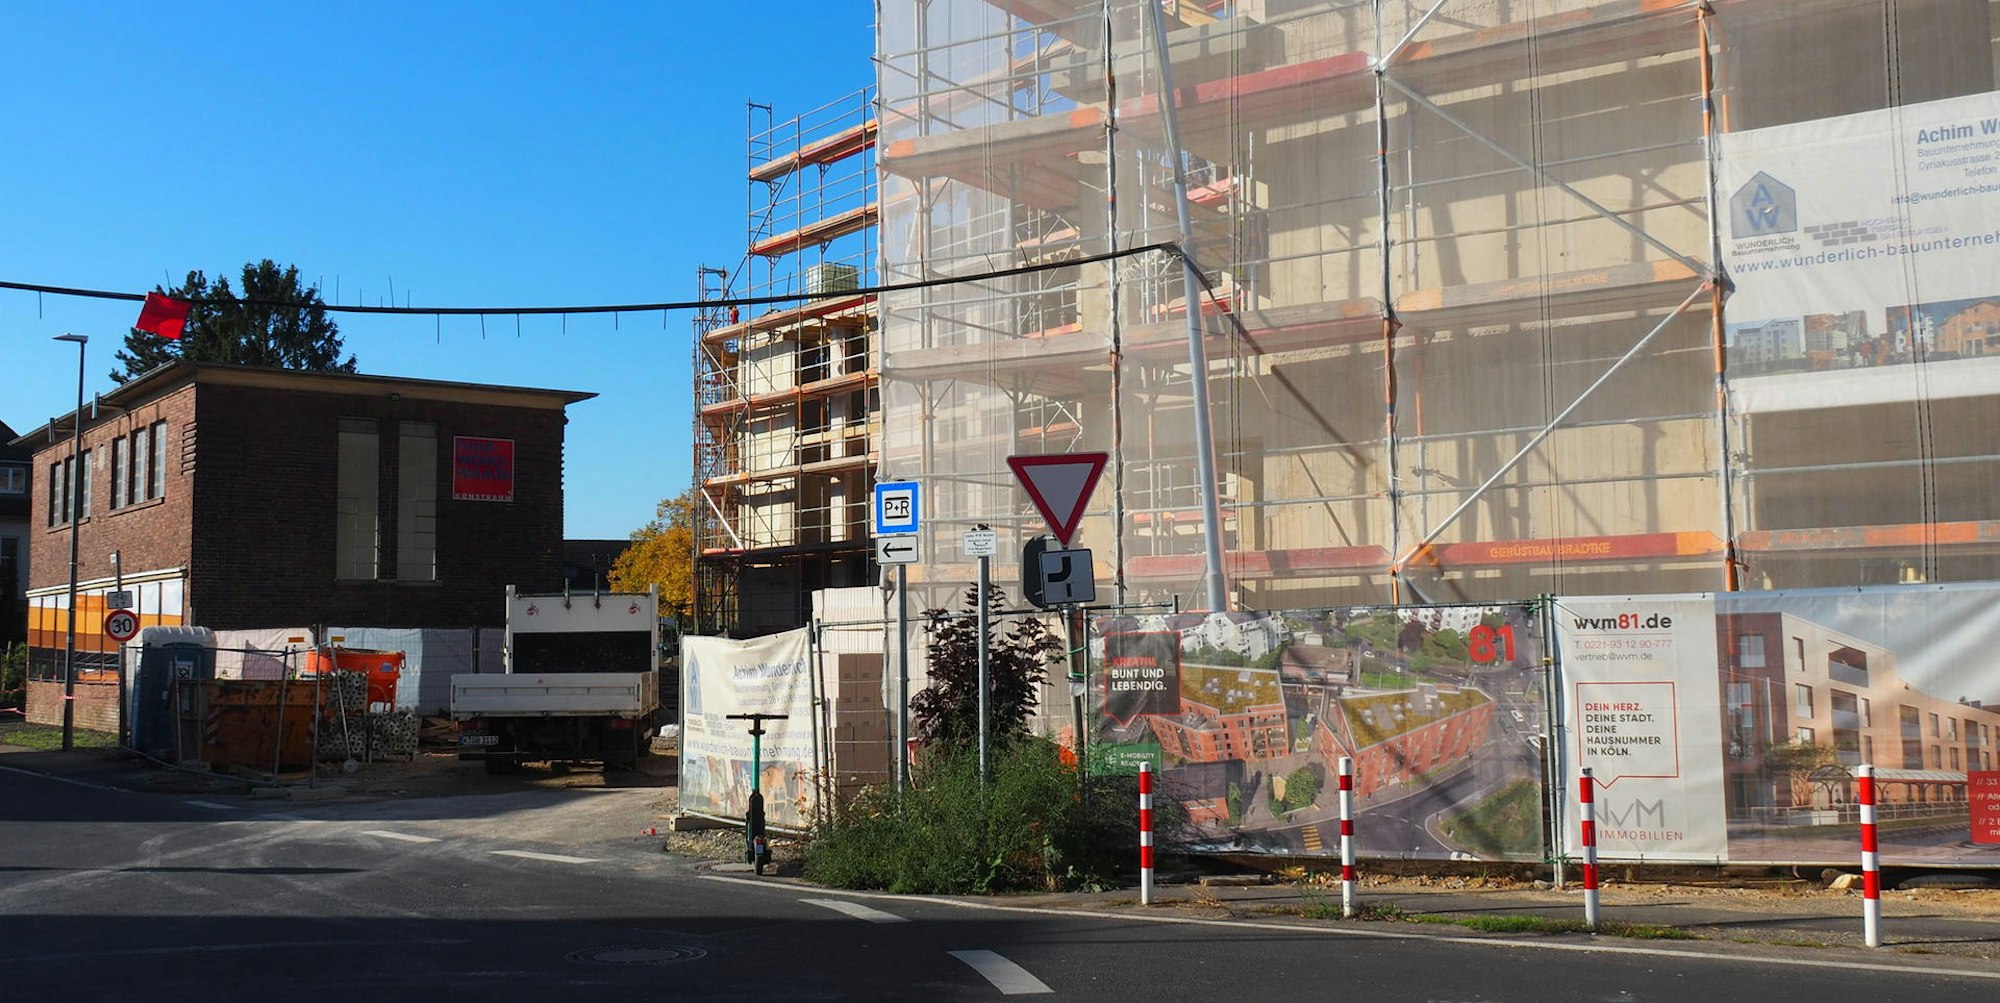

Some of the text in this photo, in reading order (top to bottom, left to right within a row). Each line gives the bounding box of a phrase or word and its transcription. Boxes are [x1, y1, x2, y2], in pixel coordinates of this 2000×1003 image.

[1916, 118, 2000, 145] Achim W
[1964, 166, 1997, 178] Telefon
[1735, 236, 1795, 250] WUNDERLICH
[884, 500, 909, 515] P+R
[1489, 542, 1611, 558] GERÜSTBAU BRADTKE
[112, 618, 132, 634] 30
[1574, 613, 1672, 630] wvm81.de
[1468, 624, 1516, 662] 81
[1584, 640, 1622, 649] 0221-93
[1626, 640, 1637, 649] 12
[1639, 640, 1672, 649] 90-777
[1574, 651, 1653, 661] vertrieb@wvm.de
[1112, 668, 1165, 679] BUNT UND
[1111, 680, 1168, 691] LEBENDIG.
[1585, 703, 1643, 711] DEIN HERZ.
[1586, 714, 1655, 723] DEINE STADT.
[1586, 725, 1617, 734] DEINE
[1587, 736, 1661, 745] HAUSNUMMER
[1120, 752, 1155, 760] E-MOBILITY
[1587, 746, 1632, 756] IN KÖLN.
[1986, 778, 1998, 786] 33
[1988, 818, 1995, 826] 2
[1599, 829, 1684, 841] IMMOBILIEN
